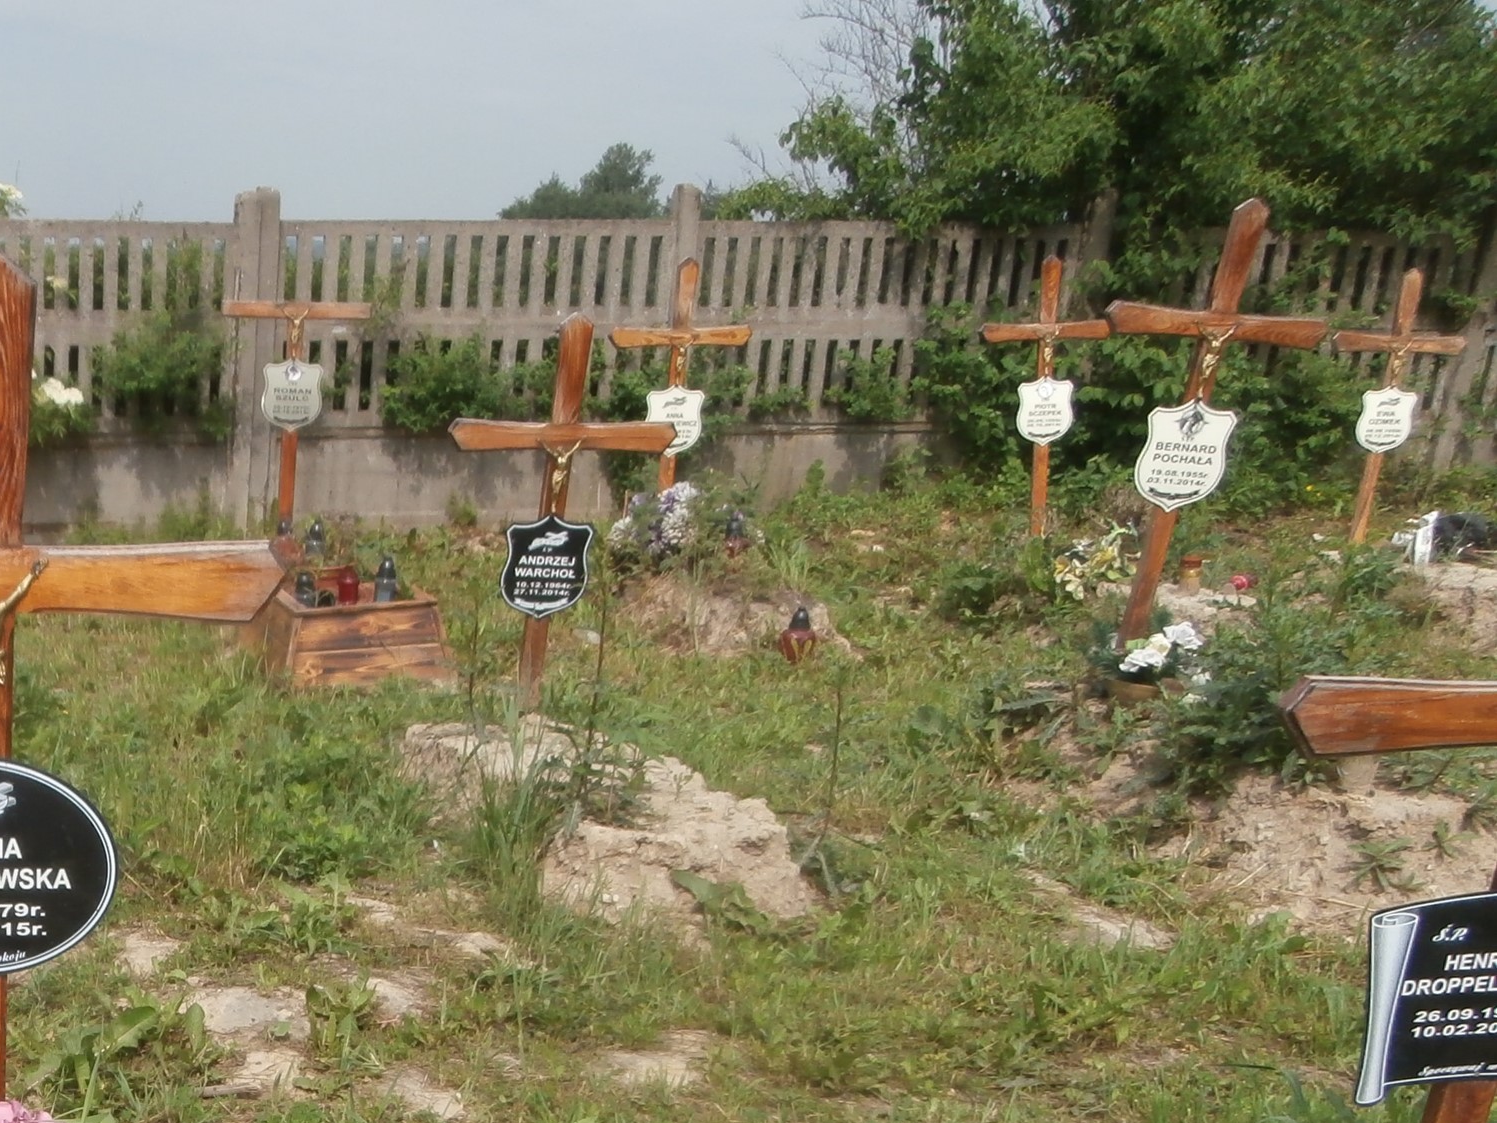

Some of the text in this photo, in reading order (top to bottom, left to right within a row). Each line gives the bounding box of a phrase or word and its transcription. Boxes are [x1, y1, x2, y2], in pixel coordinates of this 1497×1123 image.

[1155, 441, 1217, 454] BERNARD
[518, 555, 576, 567] ANDRZEJ
[514, 567, 576, 579] WARCHOŁ
[1401, 975, 1497, 997] DROPPEL
[1413, 1006, 1497, 1023] 26.09.1
